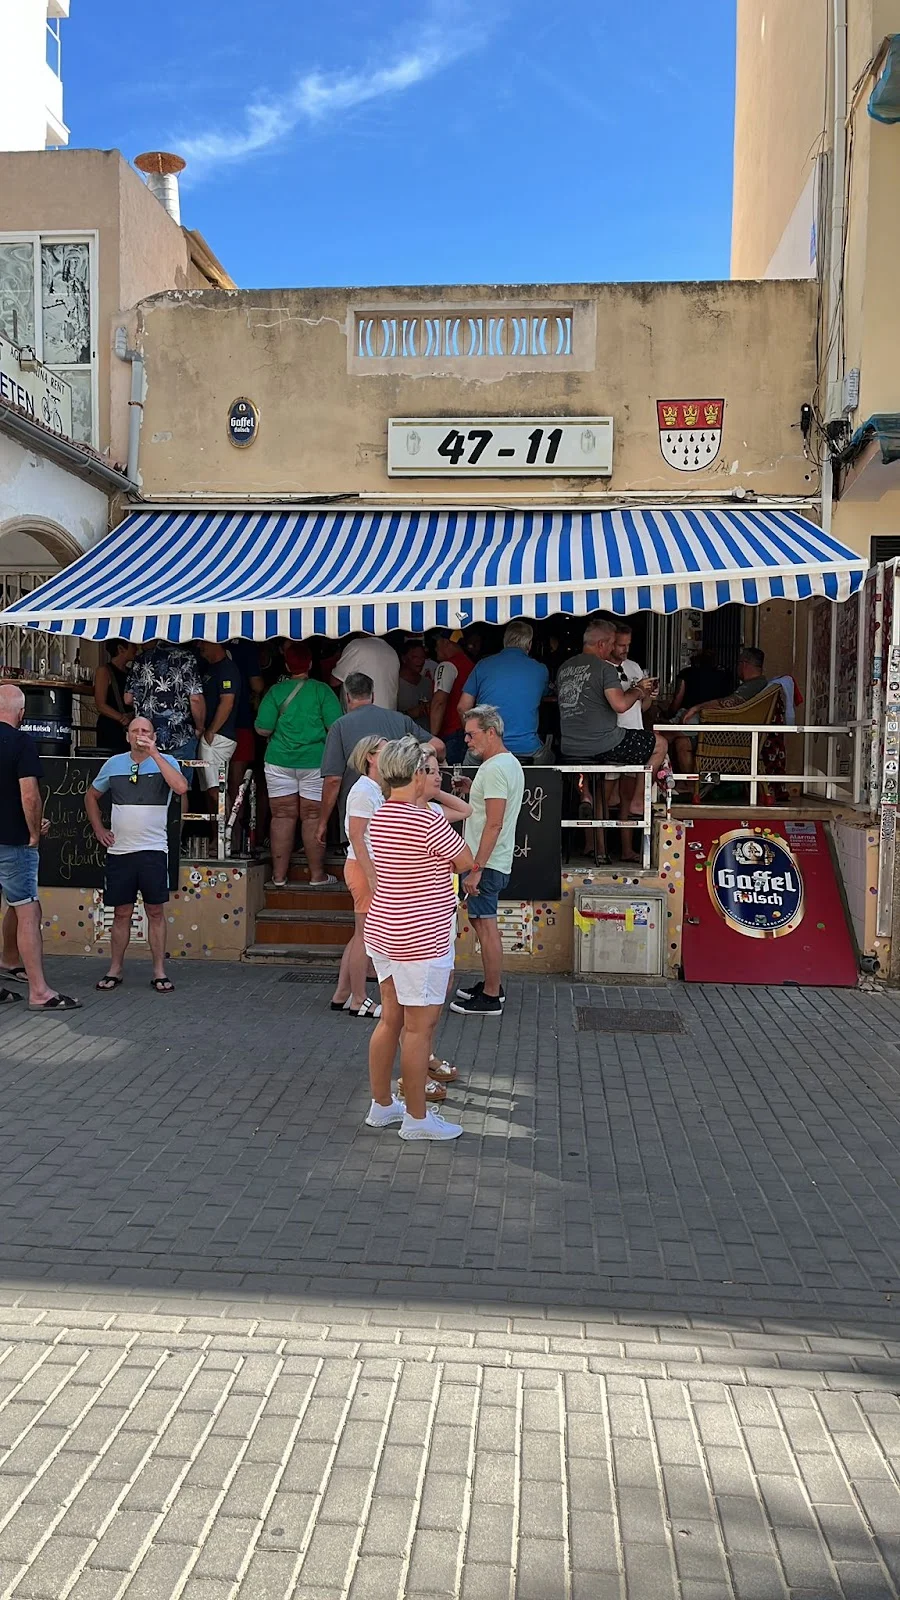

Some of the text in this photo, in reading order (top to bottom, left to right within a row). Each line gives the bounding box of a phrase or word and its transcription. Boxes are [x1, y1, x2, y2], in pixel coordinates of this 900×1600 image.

[50, 377, 65, 395] RENT
[230, 416, 255, 427] Gaffel
[718, 868, 797, 893] Gaffel
